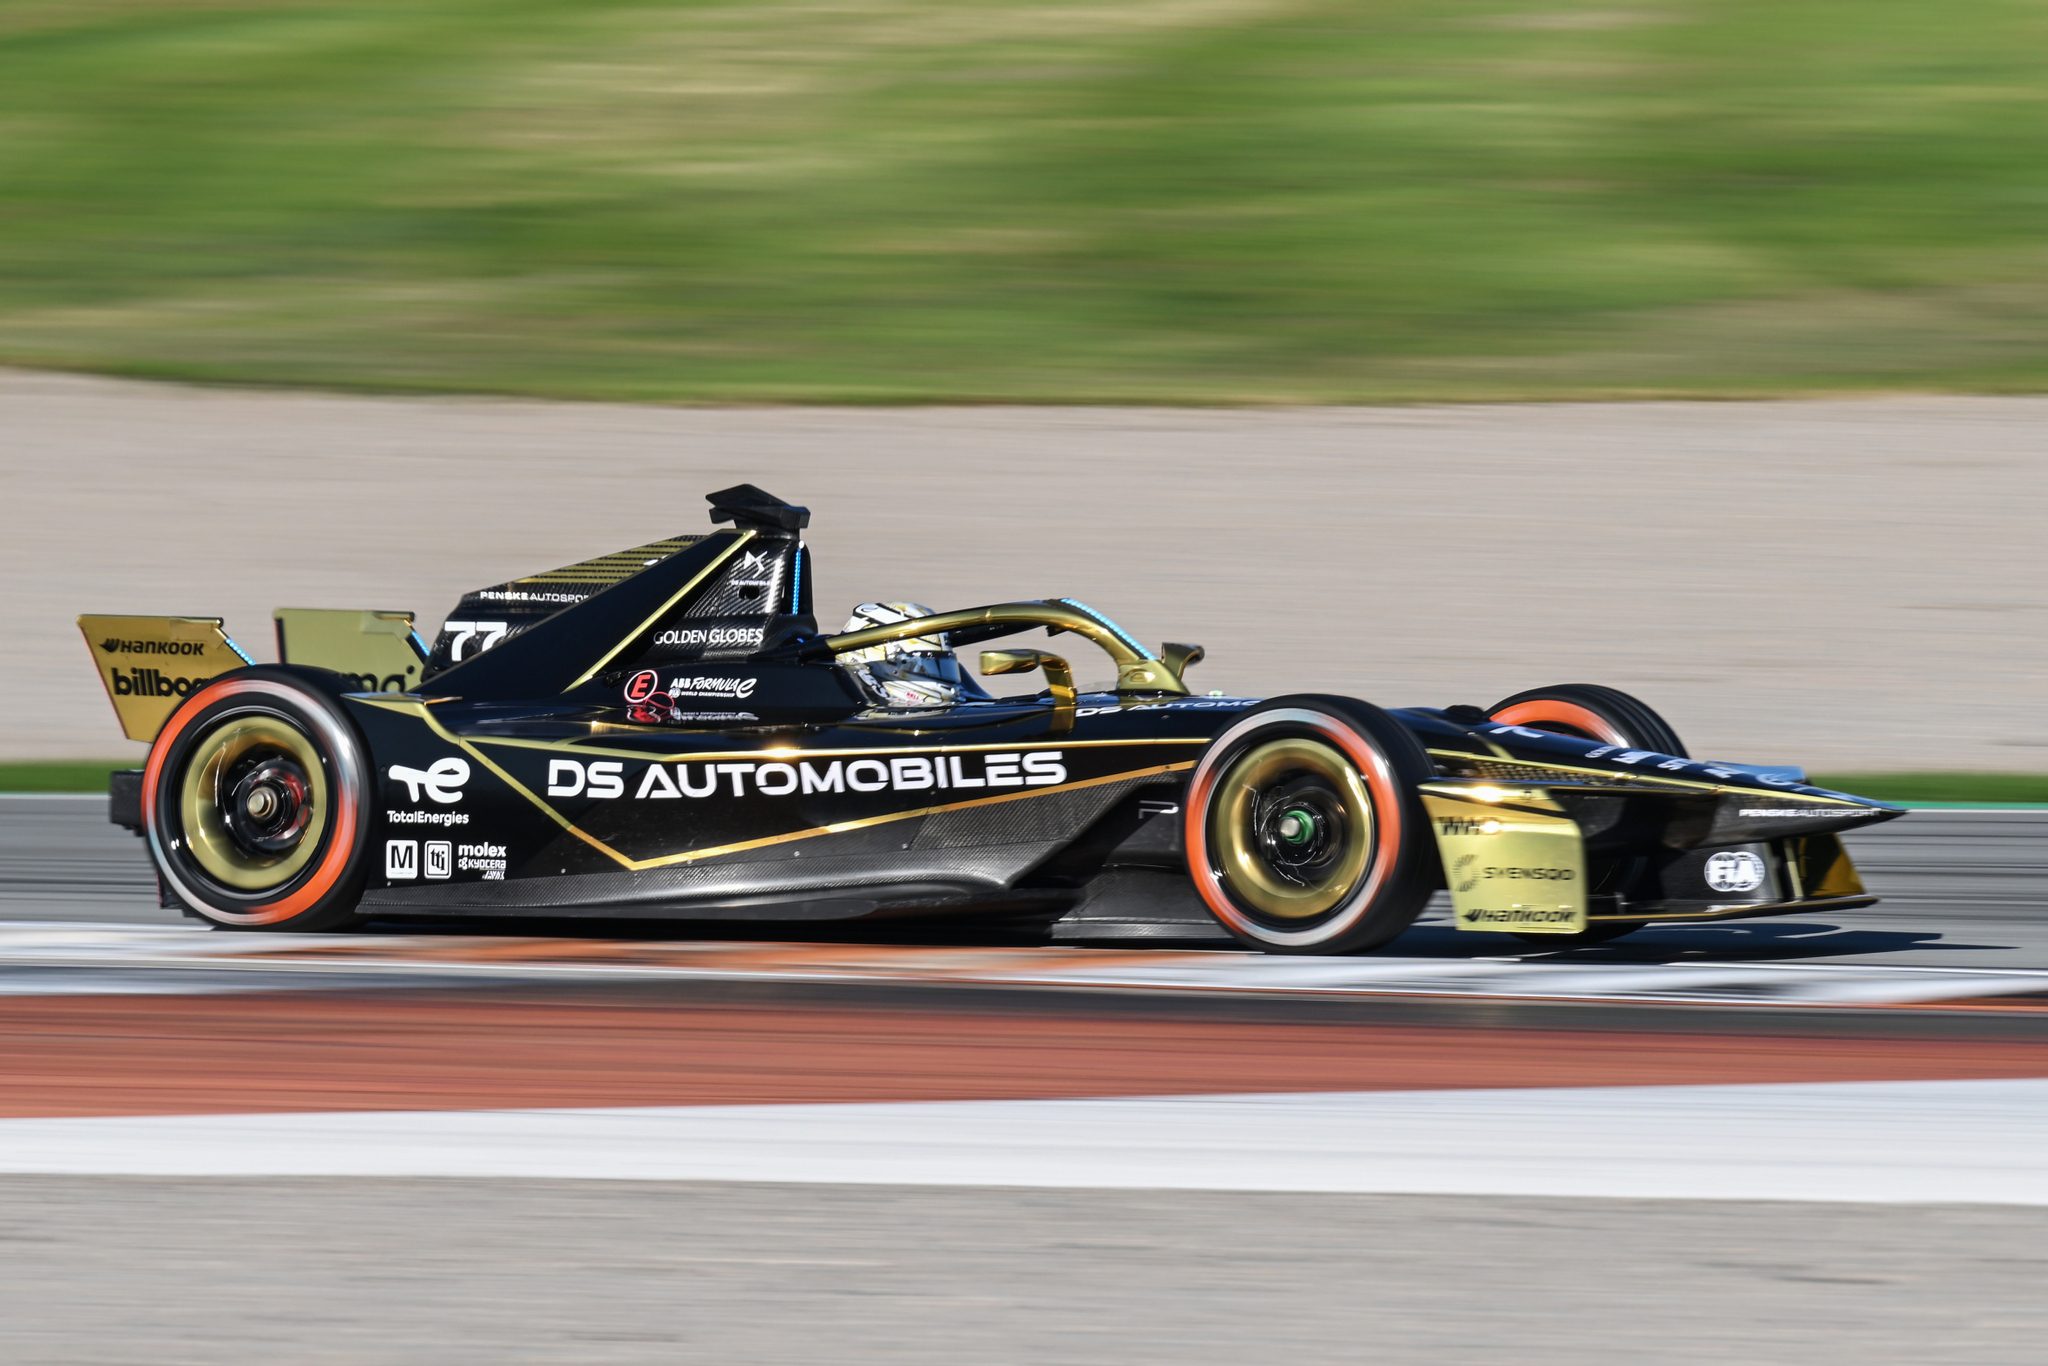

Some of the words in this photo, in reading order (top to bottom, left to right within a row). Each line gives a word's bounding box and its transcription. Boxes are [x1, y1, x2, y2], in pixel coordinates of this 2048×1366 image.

[480, 591, 529, 601] PENSKE
[530, 592, 590, 604] AUTOSPO
[444, 621, 508, 662] 77
[653, 629, 707, 645] GOLDEN
[708, 628, 764, 643] GLOBES
[670, 677, 691, 688] ABB
[690, 677, 741, 692] FORMULA
[1075, 706, 1123, 718] DS
[547, 759, 625, 799] DS
[634, 751, 1068, 799] AUTOMOBILES
[386, 810, 470, 827] TotalEnergies
[390, 845, 414, 869] M
[458, 842, 507, 858] molex
[468, 858, 507, 870] KYOCERA
